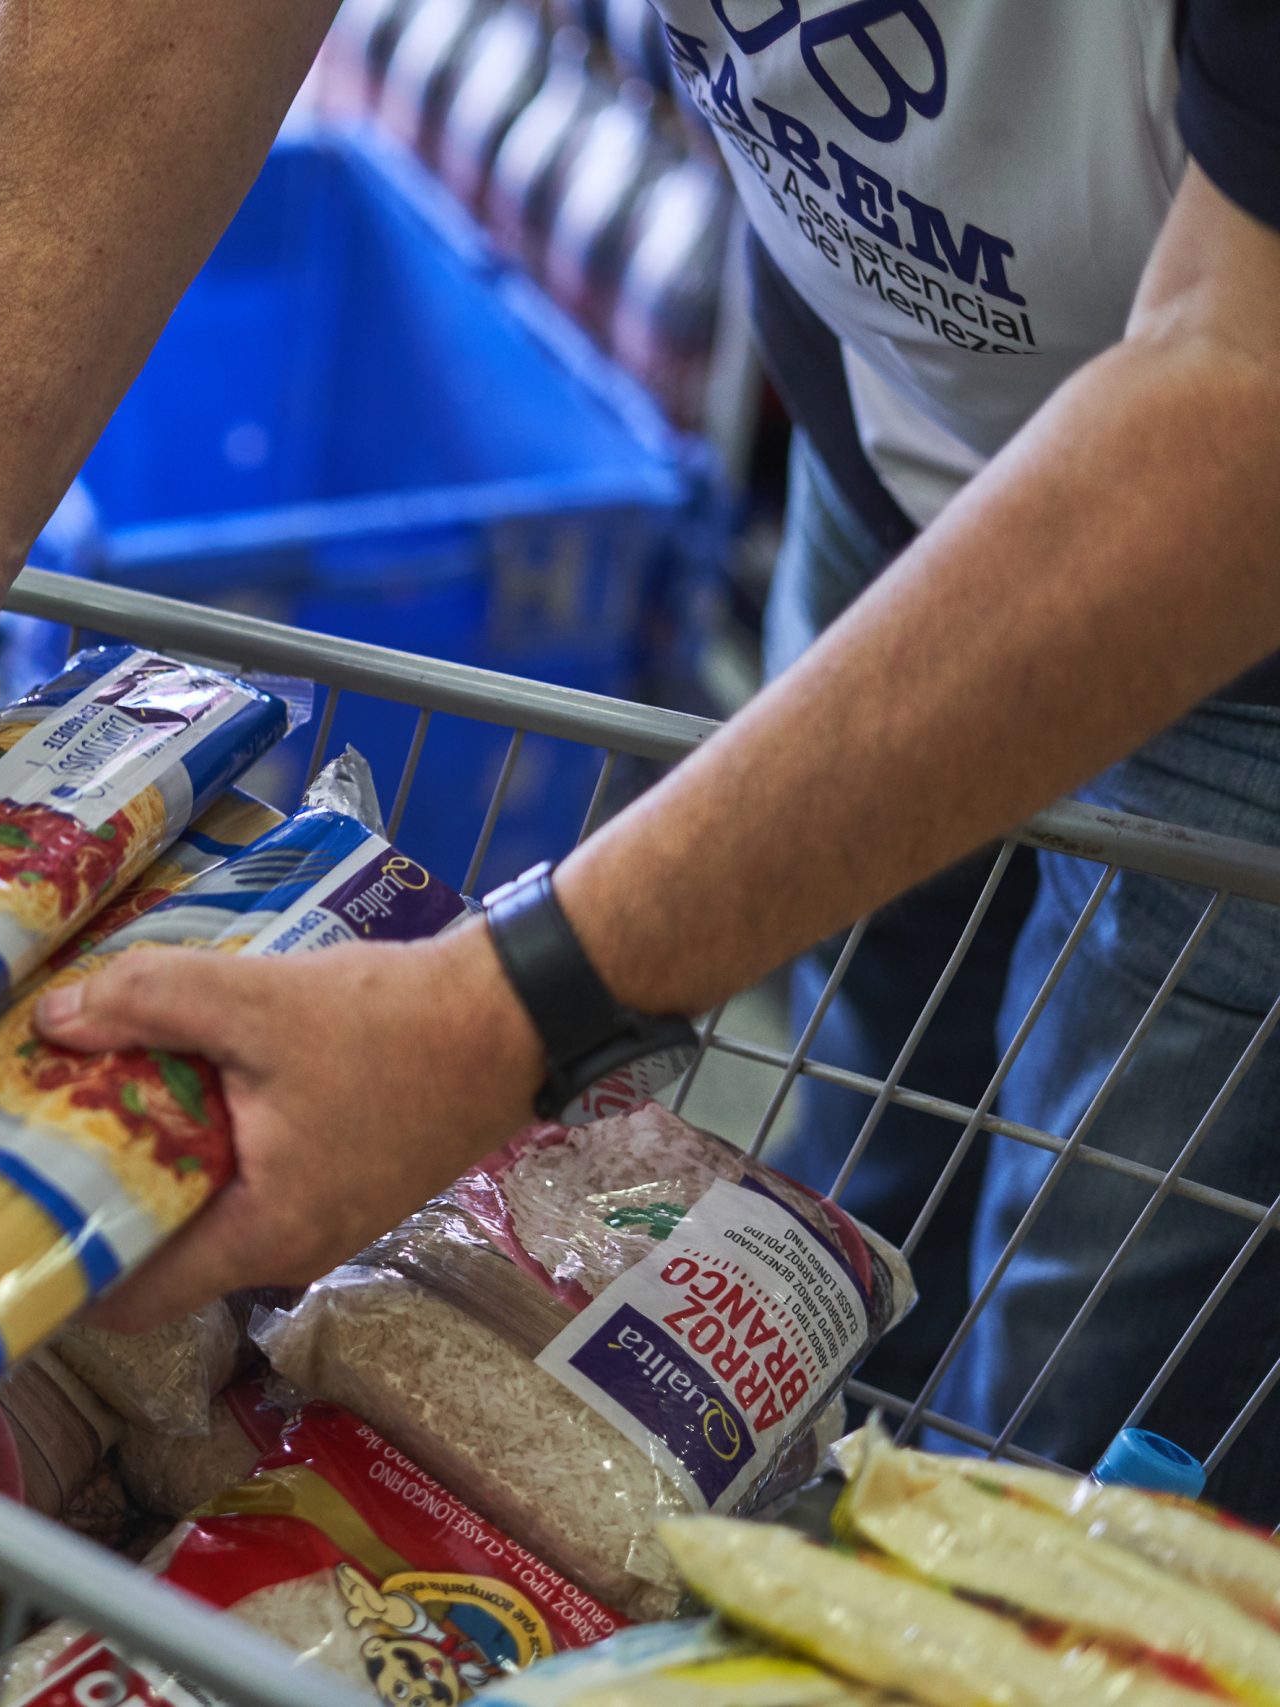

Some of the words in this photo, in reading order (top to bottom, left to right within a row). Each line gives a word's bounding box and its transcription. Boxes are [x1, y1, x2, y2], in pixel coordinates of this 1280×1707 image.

[783, 169, 1036, 346] Assistencial
[797, 213, 840, 267] de
[342, 856, 429, 934] Qualitá
[723, 1229, 795, 1283] BENEFICIADO
[743, 1226, 787, 1254] POLIDO
[784, 1229, 808, 1254] FINO
[784, 1252, 817, 1285] ARROZ
[808, 1253, 837, 1291] LONGO
[791, 1303, 811, 1333] TIPO
[792, 1280, 821, 1318] ARROZ
[814, 1285, 849, 1347] SUBGRUPO
[834, 1289, 858, 1335] CLASSE
[660, 1257, 810, 1416] BRANCO
[808, 1329, 830, 1370] ARROZ
[817, 1318, 839, 1359] GRUPO
[662, 1295, 785, 1434] ARROZ
[607, 1325, 741, 1461] Qualitá
[369, 1461, 407, 1493] FINO
[402, 1482, 458, 1525] LONGO
[452, 1515, 504, 1557] CLASSE
[511, 1562, 522, 1573] 1
[520, 1570, 554, 1602] TIPO
[428, 1581, 515, 1612] acompanha
[563, 1584, 615, 1634] GRUPO
[512, 1607, 538, 1634] que
[551, 1597, 601, 1643] ARROZ
